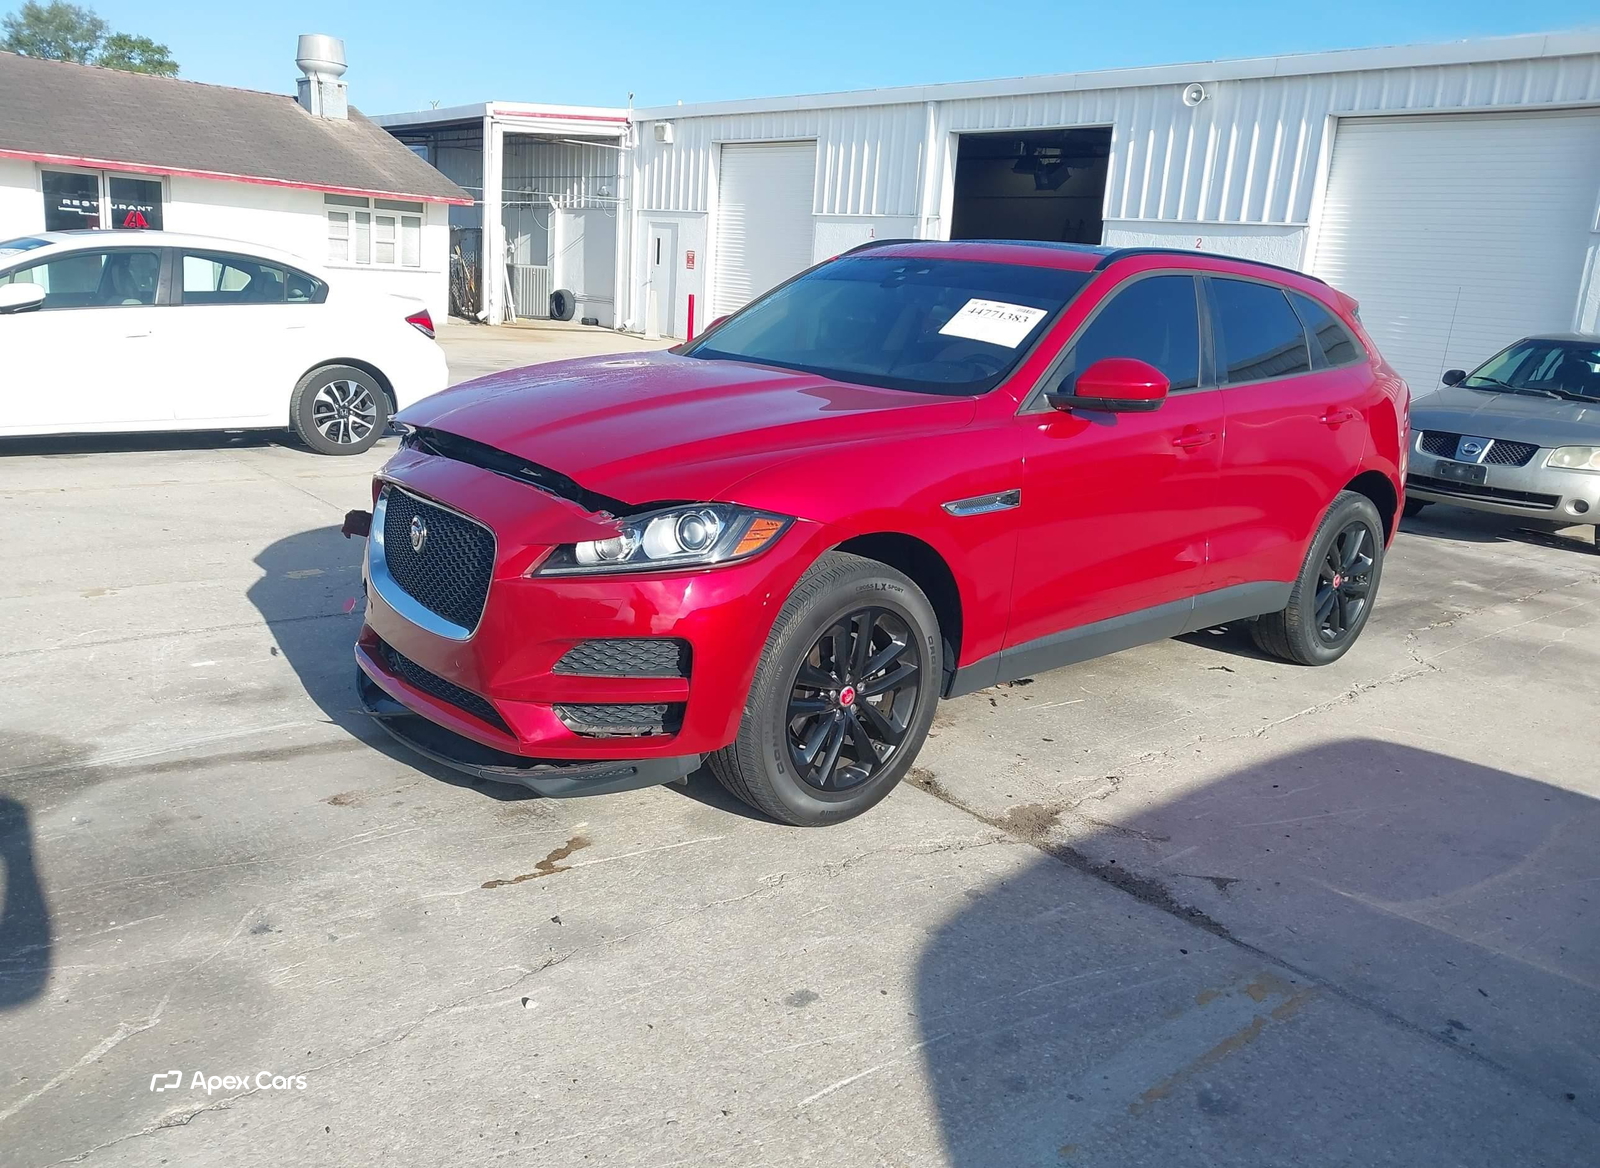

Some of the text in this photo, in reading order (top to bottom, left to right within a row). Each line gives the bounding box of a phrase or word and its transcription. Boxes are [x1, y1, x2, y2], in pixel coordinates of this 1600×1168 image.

[62, 199, 153, 212] RESTURANT
[869, 228, 875, 238] 1
[1195, 237, 1203, 249] 2
[967, 307, 1029, 323] 44771383
[875, 582, 887, 592] LX
